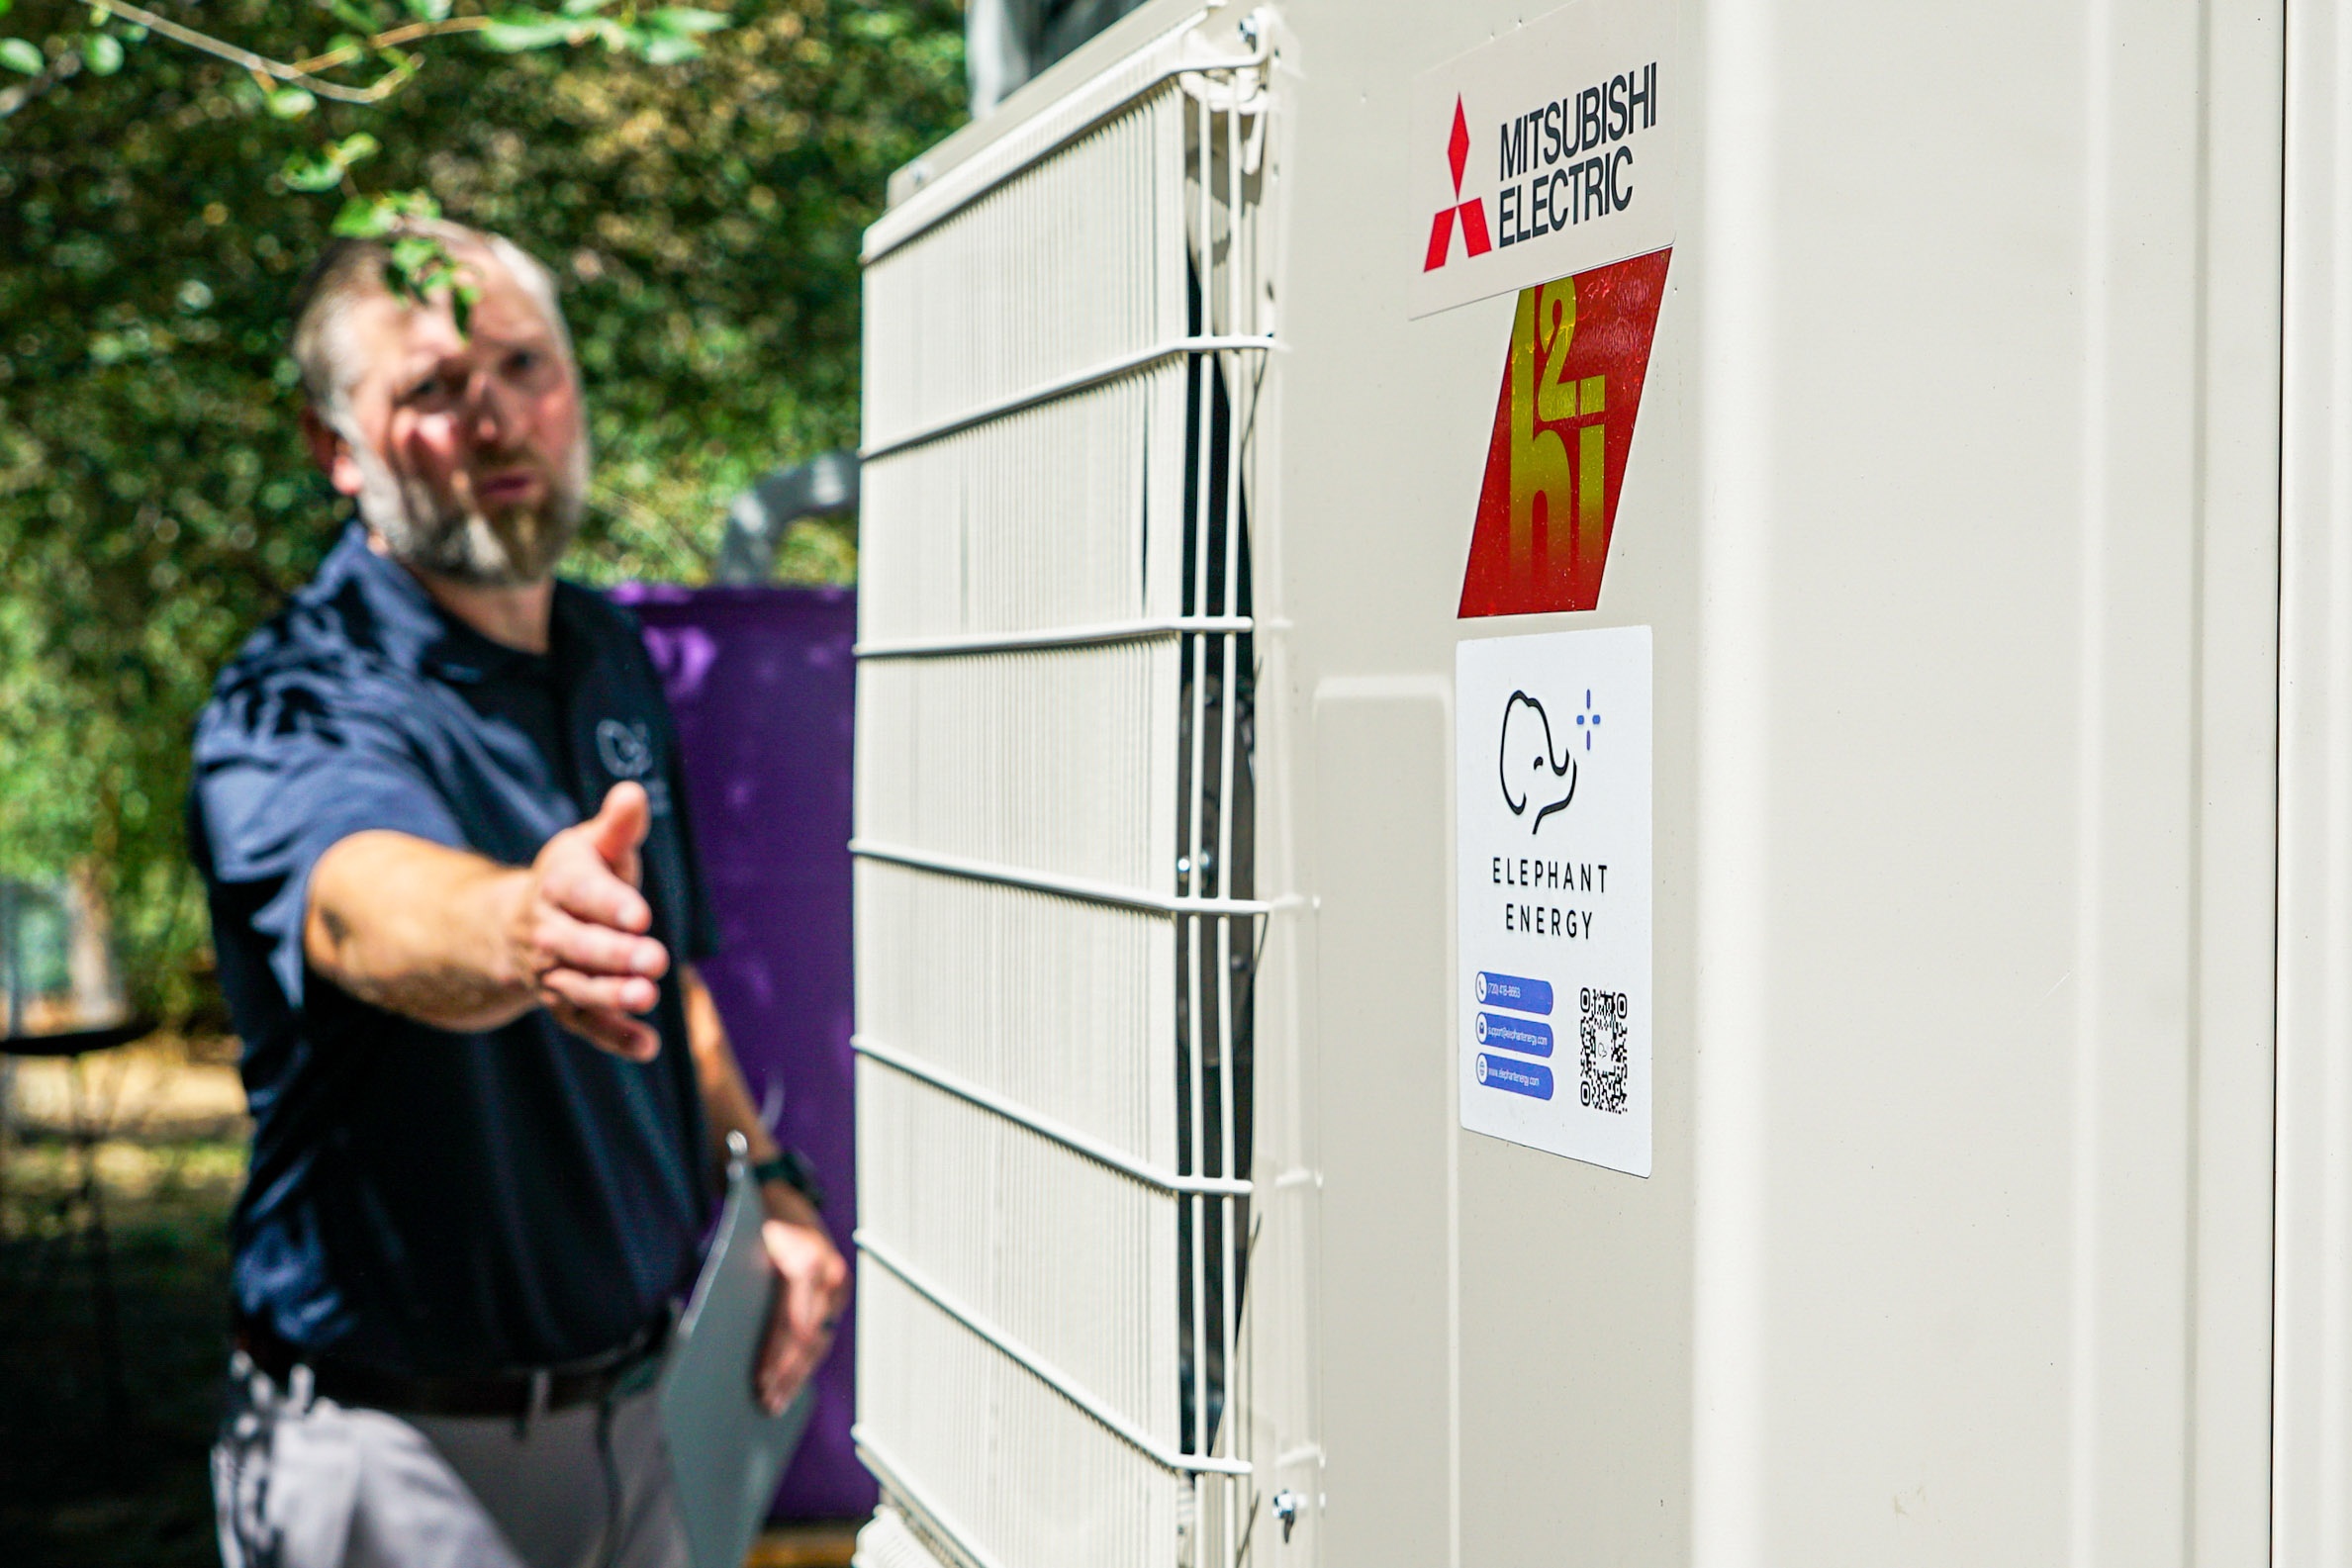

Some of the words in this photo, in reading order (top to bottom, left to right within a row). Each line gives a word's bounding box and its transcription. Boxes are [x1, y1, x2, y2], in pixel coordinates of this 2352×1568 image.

[1500, 61, 1656, 182] MITSUBISHI
[1499, 145, 1634, 249] ELECTRIC
[1492, 857, 1608, 893] ELEPHANT
[1506, 903, 1593, 940] ENERGY
